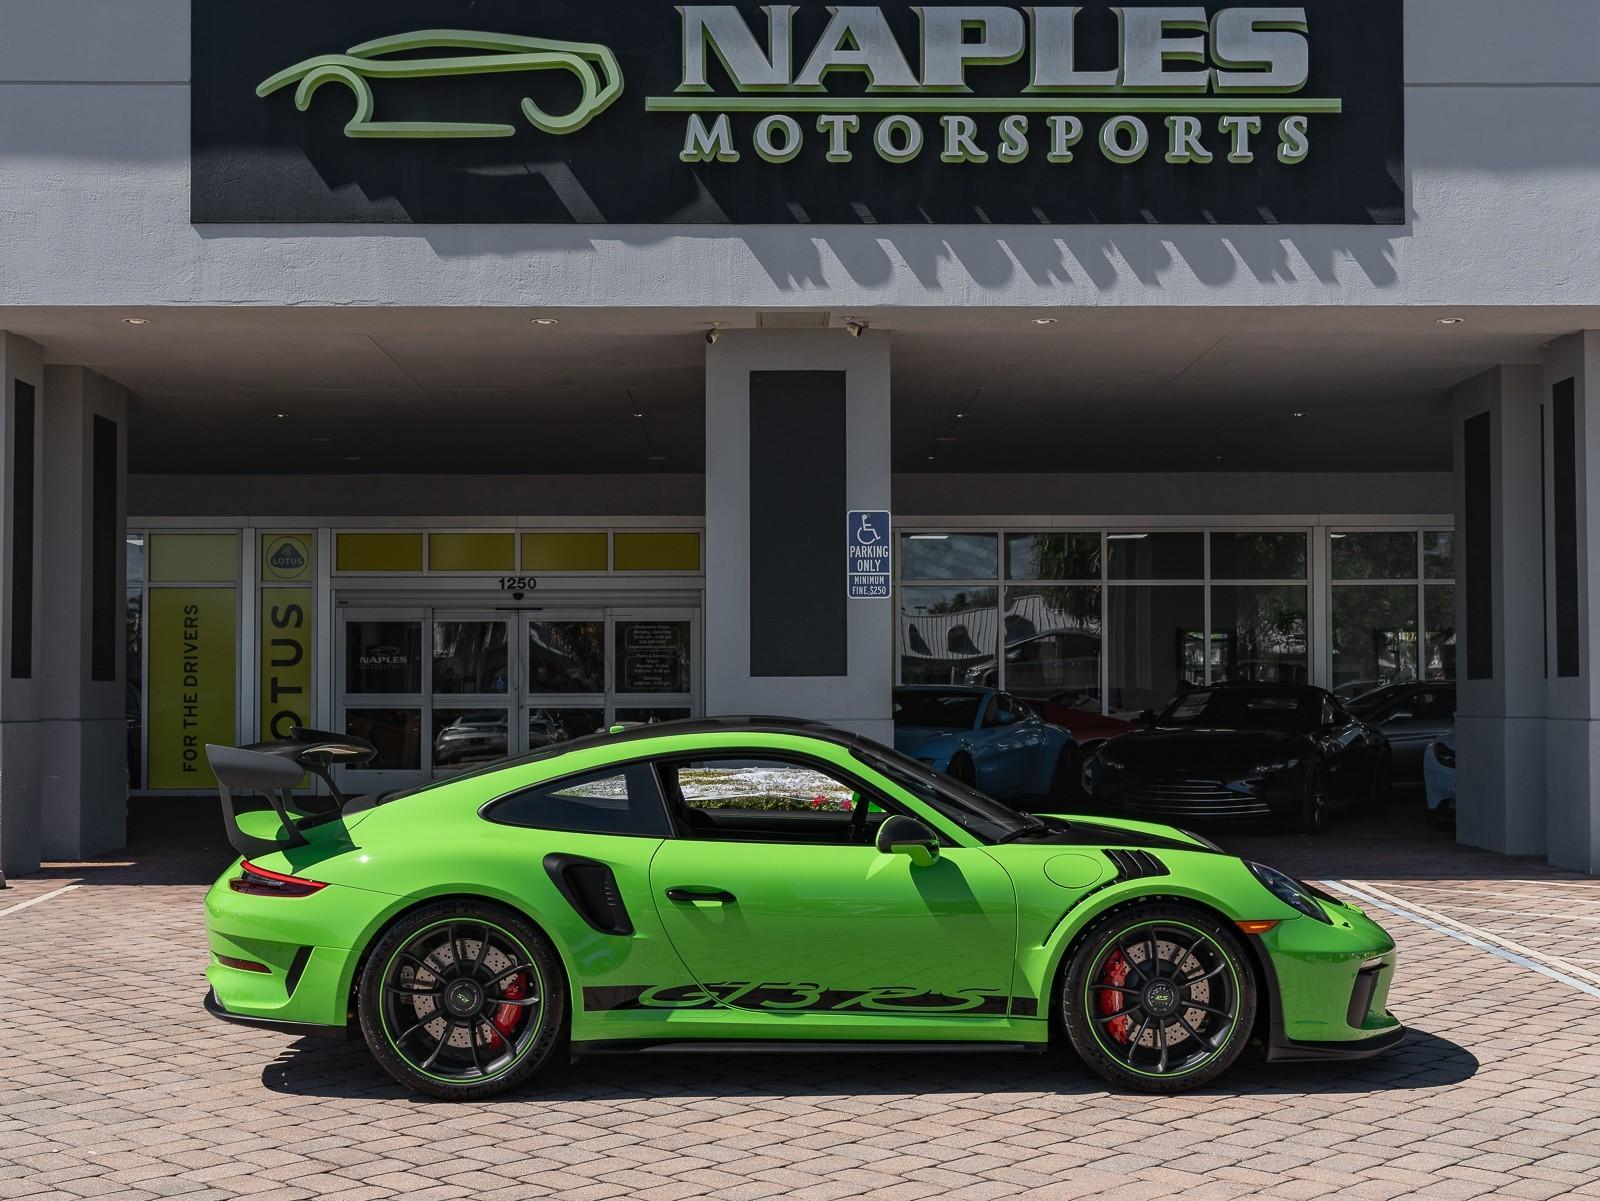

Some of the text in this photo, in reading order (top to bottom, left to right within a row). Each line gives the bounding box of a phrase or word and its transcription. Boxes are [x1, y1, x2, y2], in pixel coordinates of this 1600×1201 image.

[673, 5, 1309, 94] NAPLES
[679, 113, 1310, 163] MOTORSPORTS
[849, 545, 889, 558] PARKING
[272, 557, 305, 566] LOTUS
[857, 559, 881, 572] ONLY
[498, 577, 537, 590] 1250
[854, 576, 885, 585] MINIMUM
[852, 586, 887, 595] FINE $250
[359, 656, 408, 664] NAPLES
[270, 603, 304, 741] OTUS
[183, 604, 198, 773] FOR THE DRIVERS
